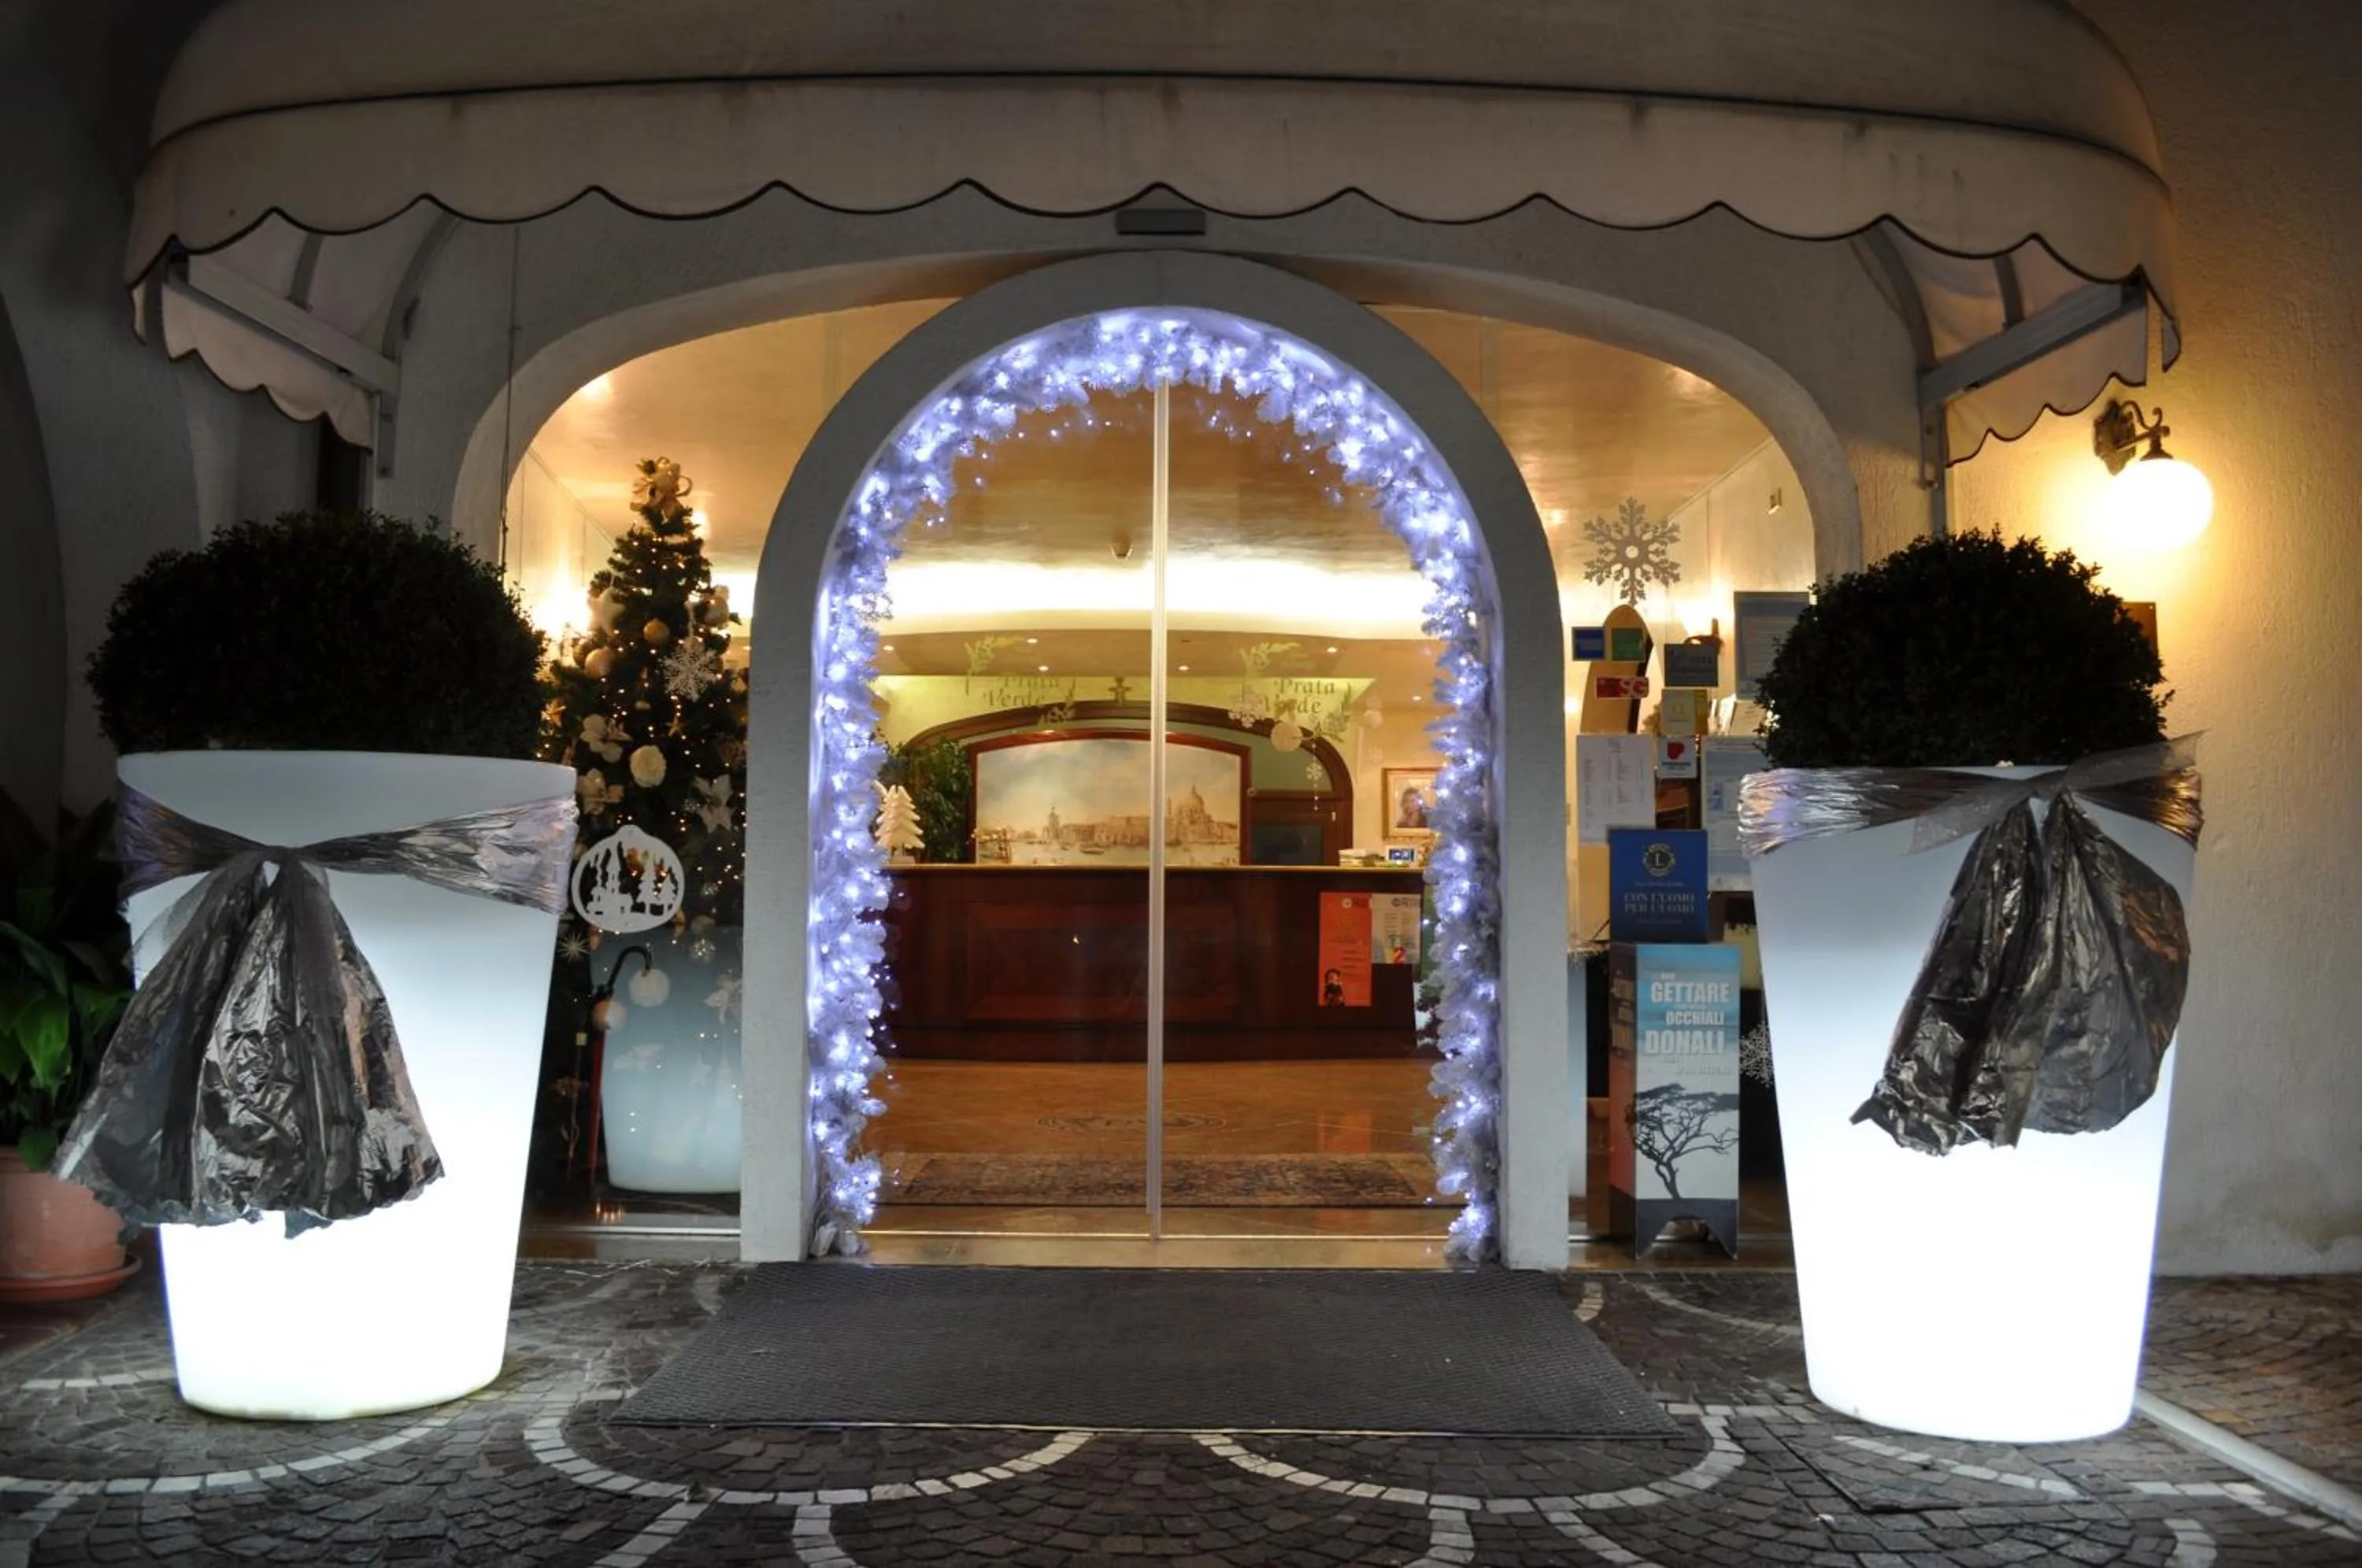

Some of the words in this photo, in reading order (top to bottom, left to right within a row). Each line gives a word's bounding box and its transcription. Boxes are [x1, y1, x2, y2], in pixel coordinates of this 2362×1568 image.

[1274, 678, 1335, 694] Prata
[983, 689, 1046, 707] Verde
[1651, 982, 1730, 1002] GETTARE
[1665, 1010, 1724, 1025] OCCHIALI
[1645, 1030, 1724, 1054] DONALI
